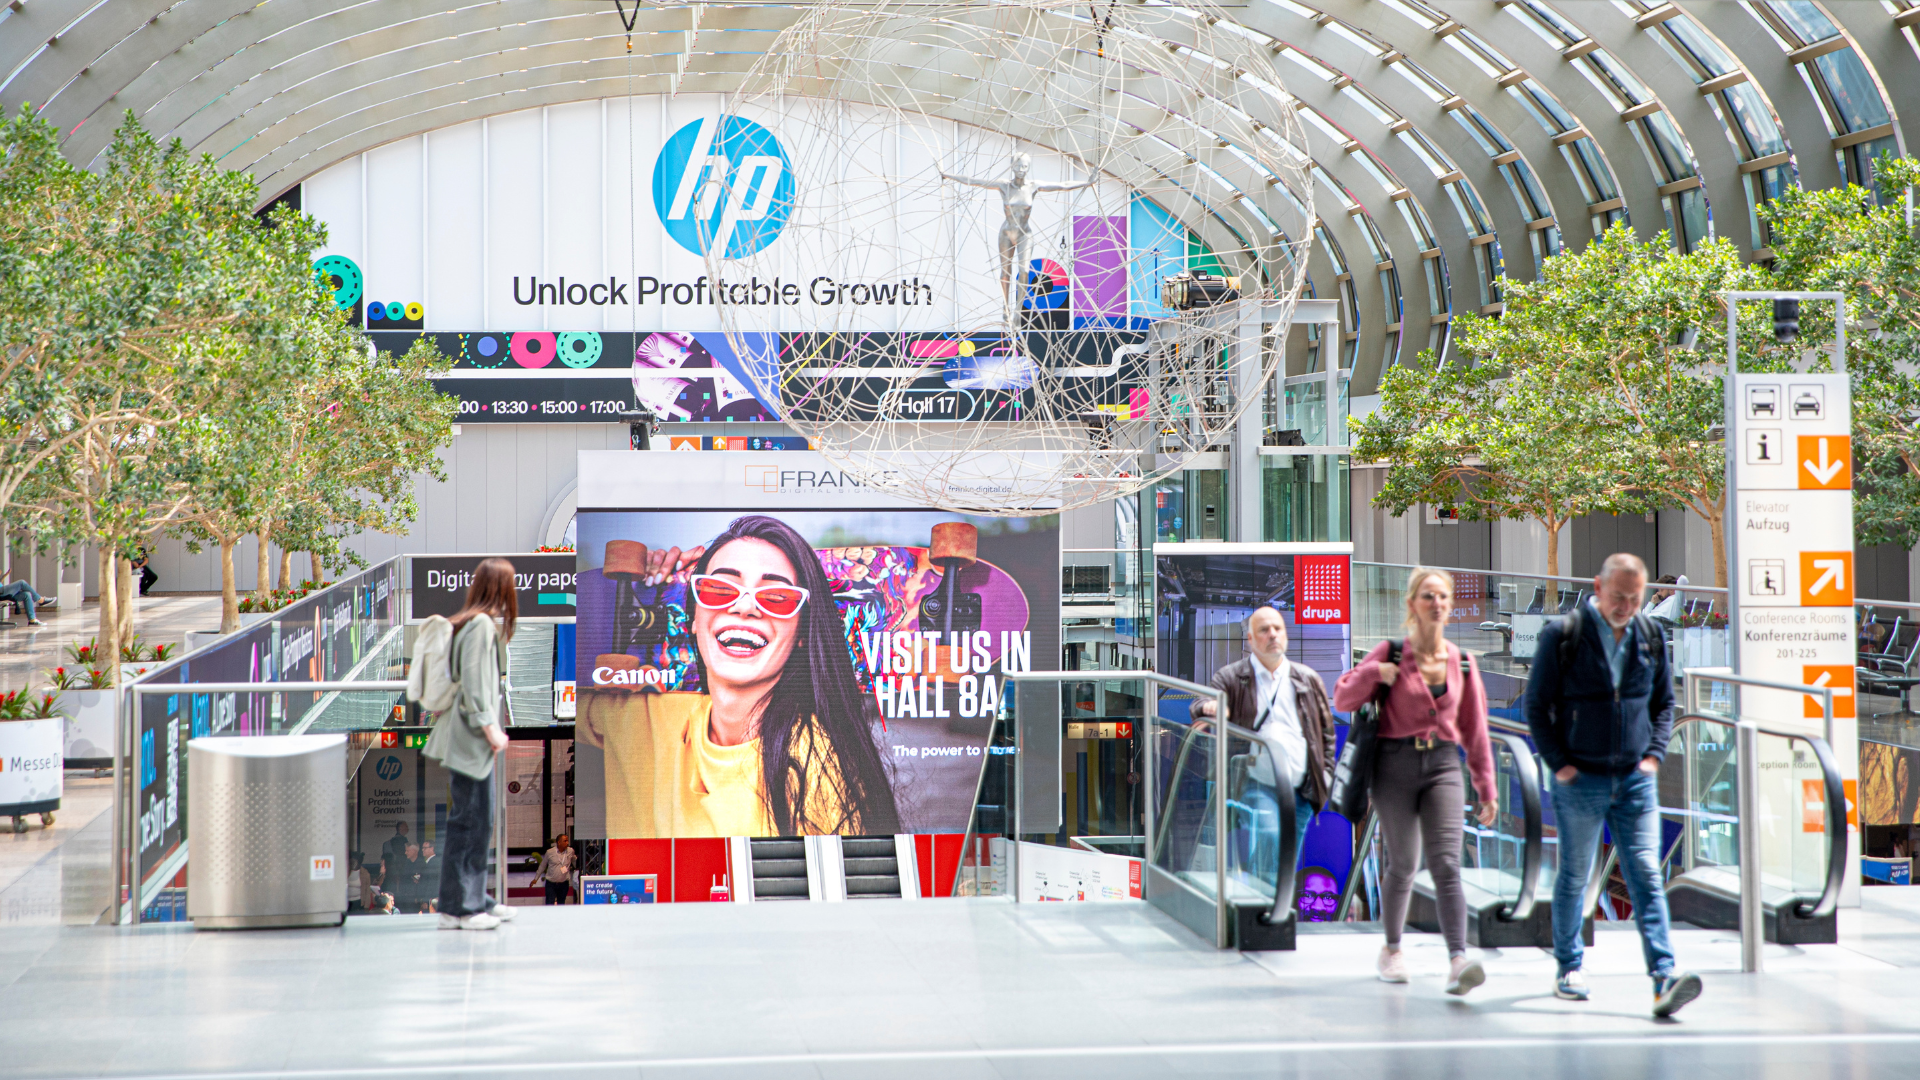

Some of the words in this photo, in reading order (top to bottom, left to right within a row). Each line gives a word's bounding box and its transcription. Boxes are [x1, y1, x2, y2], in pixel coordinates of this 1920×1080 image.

[667, 115, 784, 261] hp
[513, 276, 628, 305] Unlock
[638, 276, 801, 306] Profitable
[810, 276, 932, 306] Growth
[491, 401, 528, 414] 13:30
[540, 401, 577, 414] 15:00
[589, 401, 626, 414] 17:00
[899, 397, 933, 414] Hall
[937, 397, 956, 414] 17
[1746, 501, 1790, 513] Elevator
[1746, 519, 1790, 533] Aufzug
[427, 570, 475, 592] Digit
[1302, 605, 1341, 622] drupa
[1744, 612, 1806, 624] Conference
[1810, 612, 1847, 624] Rooms
[1745, 629, 1847, 641] Konferenzräume
[860, 630, 942, 674] VISIT
[949, 630, 993, 674] US
[1001, 630, 1031, 674] IN
[1776, 649, 1817, 658] 201-225
[592, 667, 676, 685] Canon
[876, 675, 950, 718] HALL
[892, 745, 918, 757] The
[921, 747, 963, 759] power
[966, 745, 980, 756] to
[10, 756, 51, 772] Messe
[377, 756, 402, 780] hp
[374, 789, 404, 797] Unlock
[368, 798, 410, 806] Profitable
[372, 806, 405, 814] Growth
